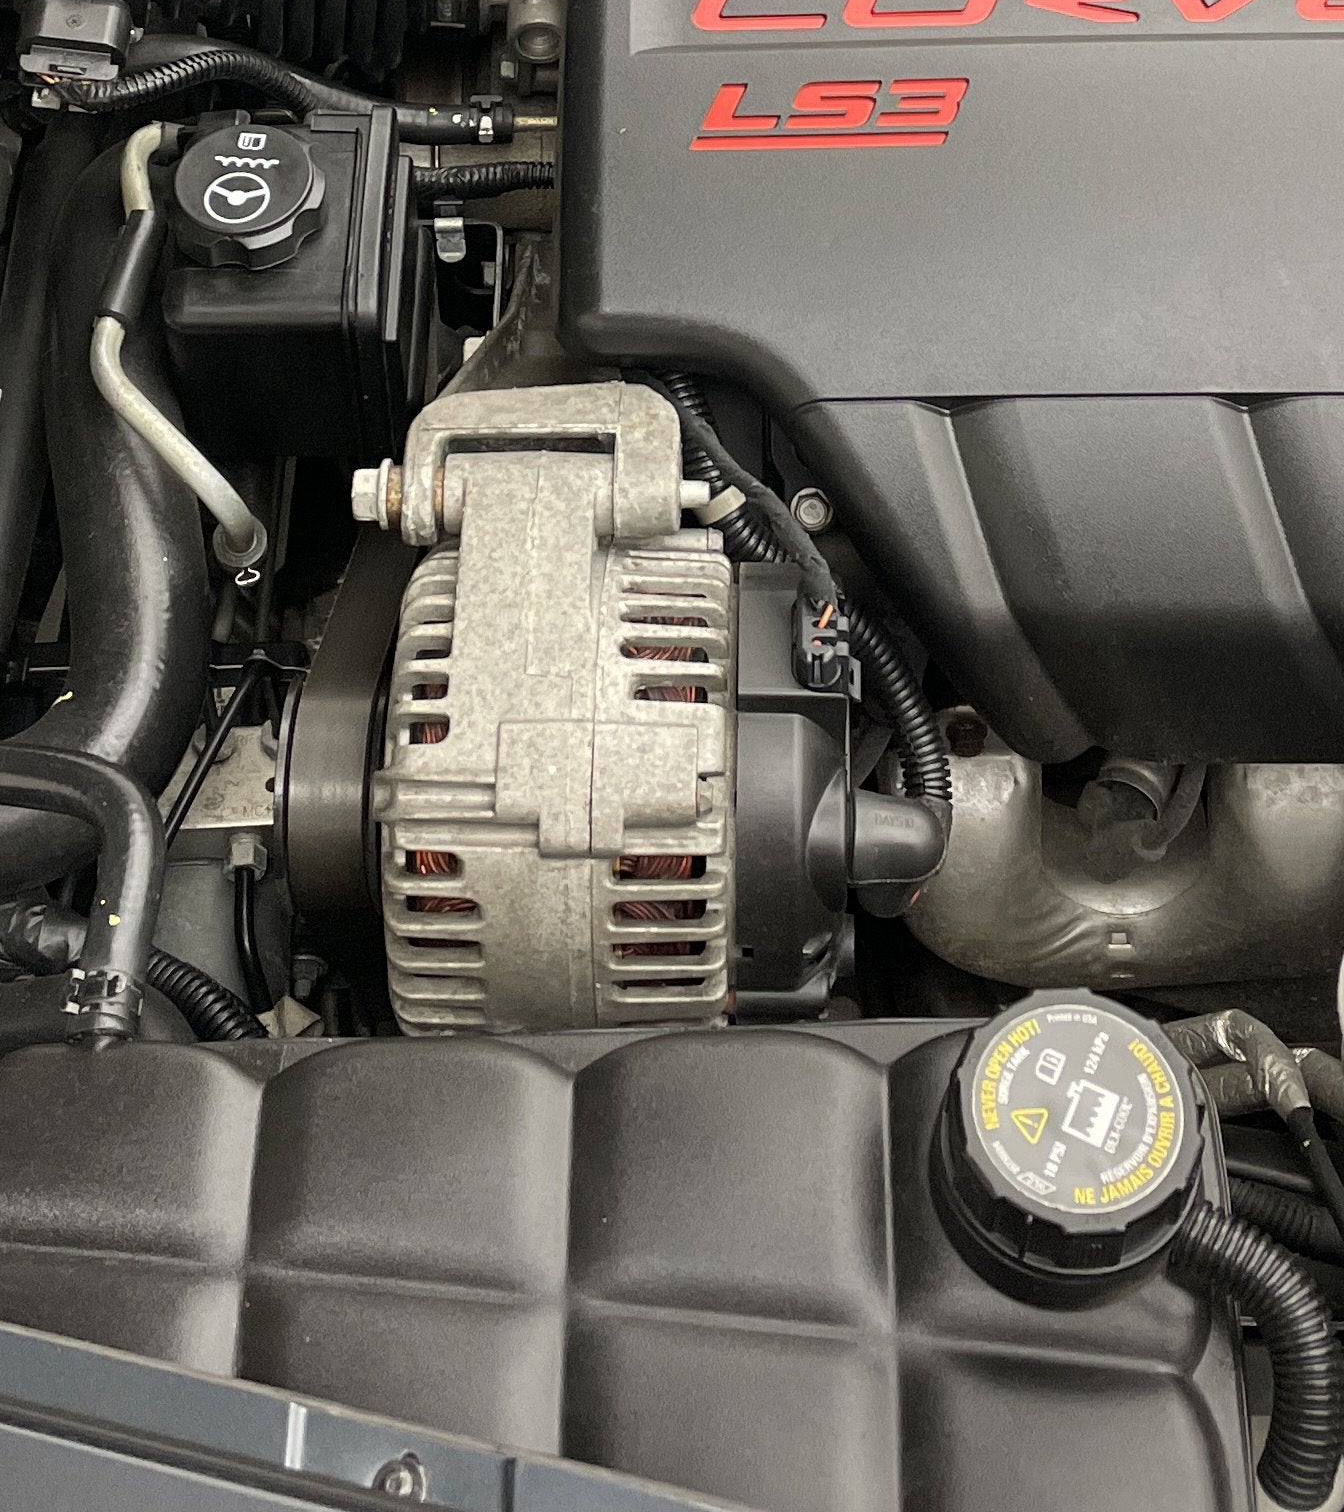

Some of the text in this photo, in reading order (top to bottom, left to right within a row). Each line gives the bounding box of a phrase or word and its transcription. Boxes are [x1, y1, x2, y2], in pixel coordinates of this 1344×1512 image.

[698, 76, 971, 134] LS3
[1082, 1014, 1097, 1025] USA
[980, 1018, 1042, 1130] NEVER OPEN HOT!
[1006, 1045, 1031, 1071] TANK
[1083, 1052, 1101, 1075] 124
[1128, 1038, 1171, 1095] CHAUD!
[1048, 1140, 1067, 1164] PSI
[1147, 1111, 1176, 1168] OUVRIR
[1073, 1187, 1097, 1205] NE
[1100, 1163, 1154, 1204] JAMAIS
